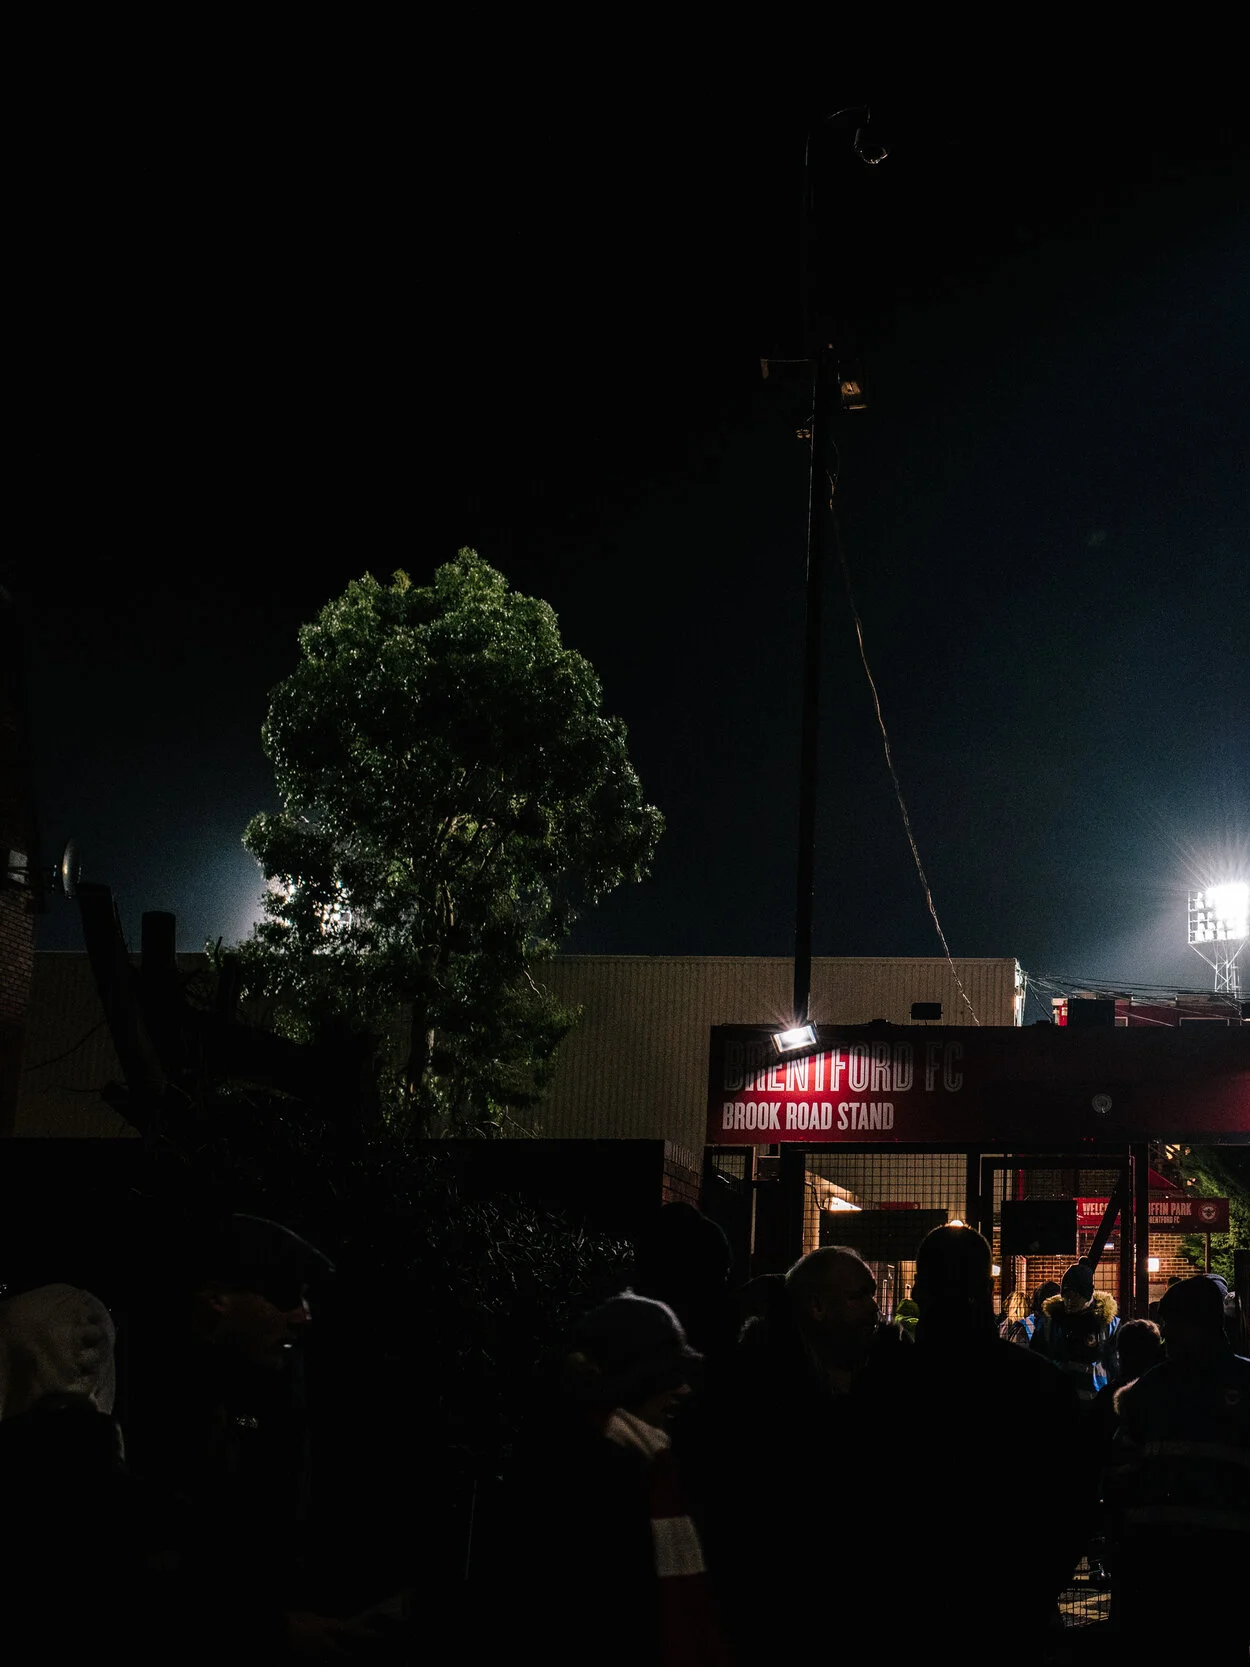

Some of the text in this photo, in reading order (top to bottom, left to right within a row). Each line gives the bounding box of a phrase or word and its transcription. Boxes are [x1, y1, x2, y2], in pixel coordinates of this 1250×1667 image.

[723, 1040, 964, 1093] BRENTFORD FC
[722, 1102, 894, 1130] BROOK ROAD STAND
[1082, 1202, 1109, 1216] WELC
[1148, 1202, 1169, 1216] IFFIN
[1170, 1202, 1192, 1216] PARK
[1148, 1215, 1173, 1224] RENTFORD
